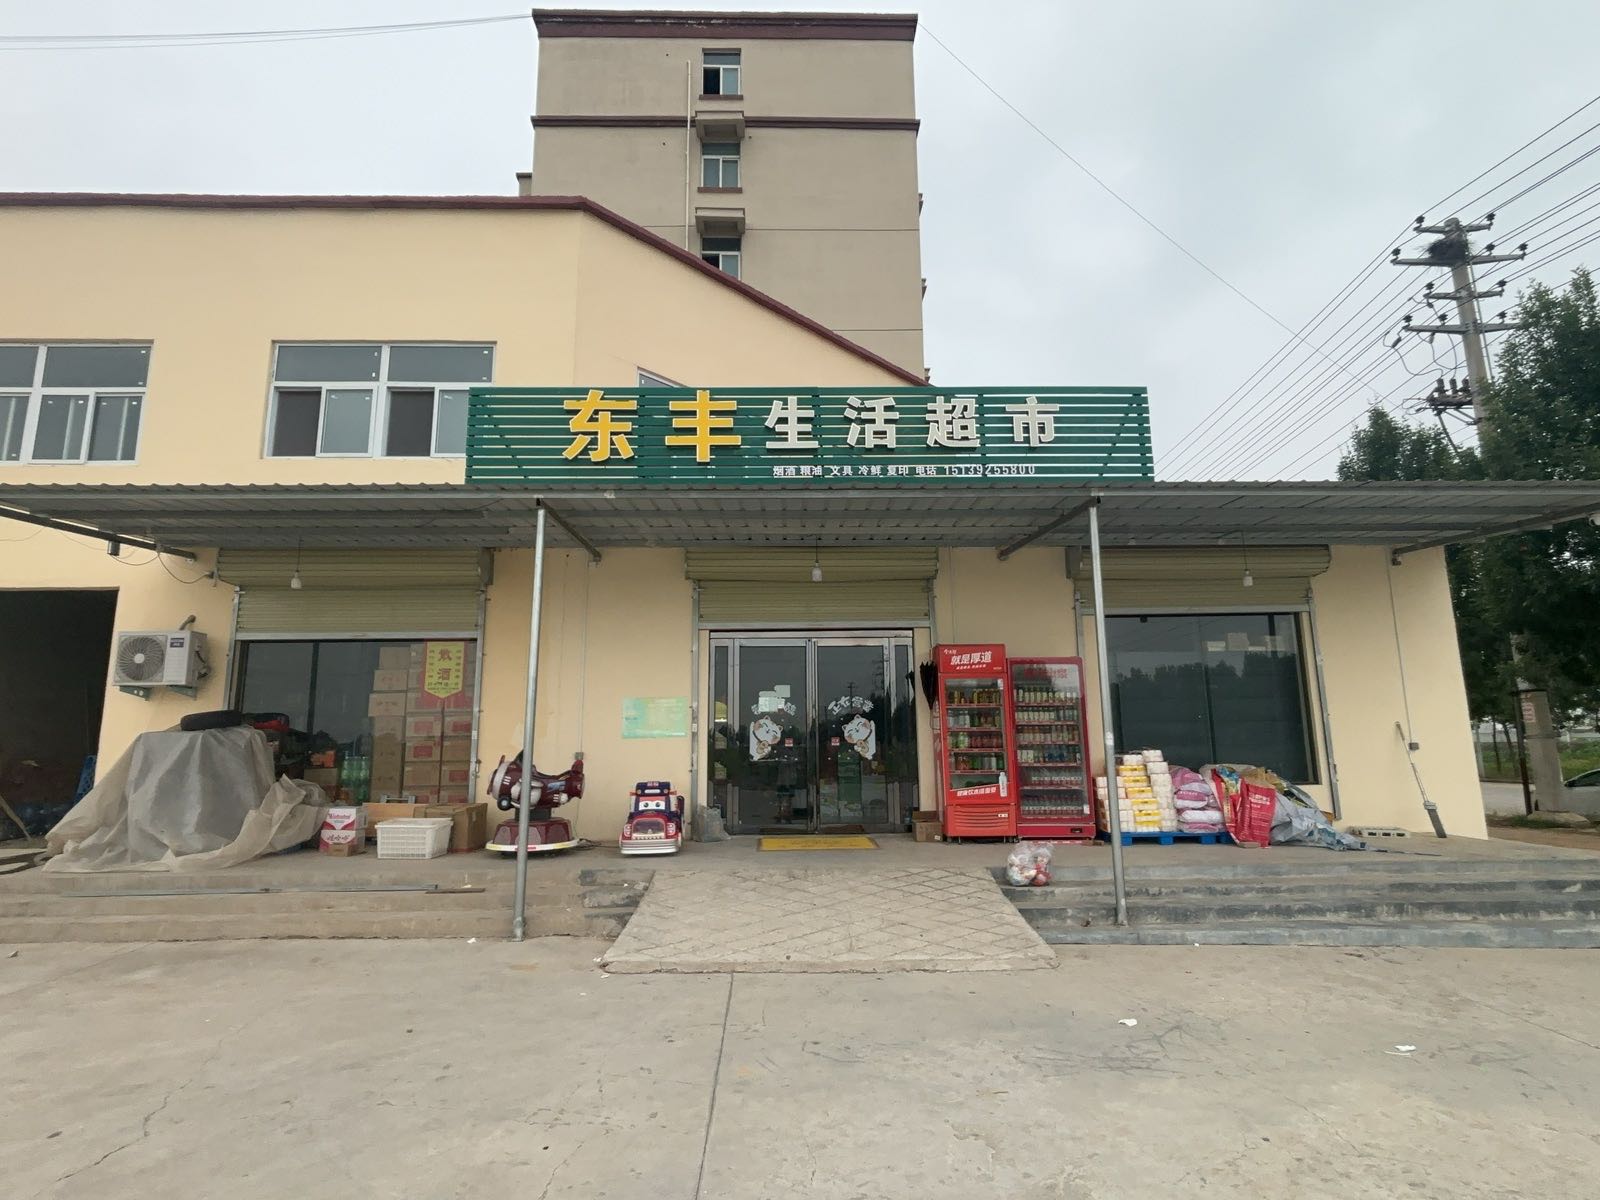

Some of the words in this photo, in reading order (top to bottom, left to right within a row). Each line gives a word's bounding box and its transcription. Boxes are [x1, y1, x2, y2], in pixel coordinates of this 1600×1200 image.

[562, 389, 1060, 463] 东丰生活超市
[773, 465, 796, 476] 烟酒
[800, 465, 823, 476] 粮油
[830, 465, 853, 476] 文具
[858, 465, 882, 476] 冷鲜
[887, 465, 909, 476] 复印
[915, 465, 937, 476] 电话
[943, 465, 1035, 476] 15139255800
[827, 695, 874, 716] 正在营业
